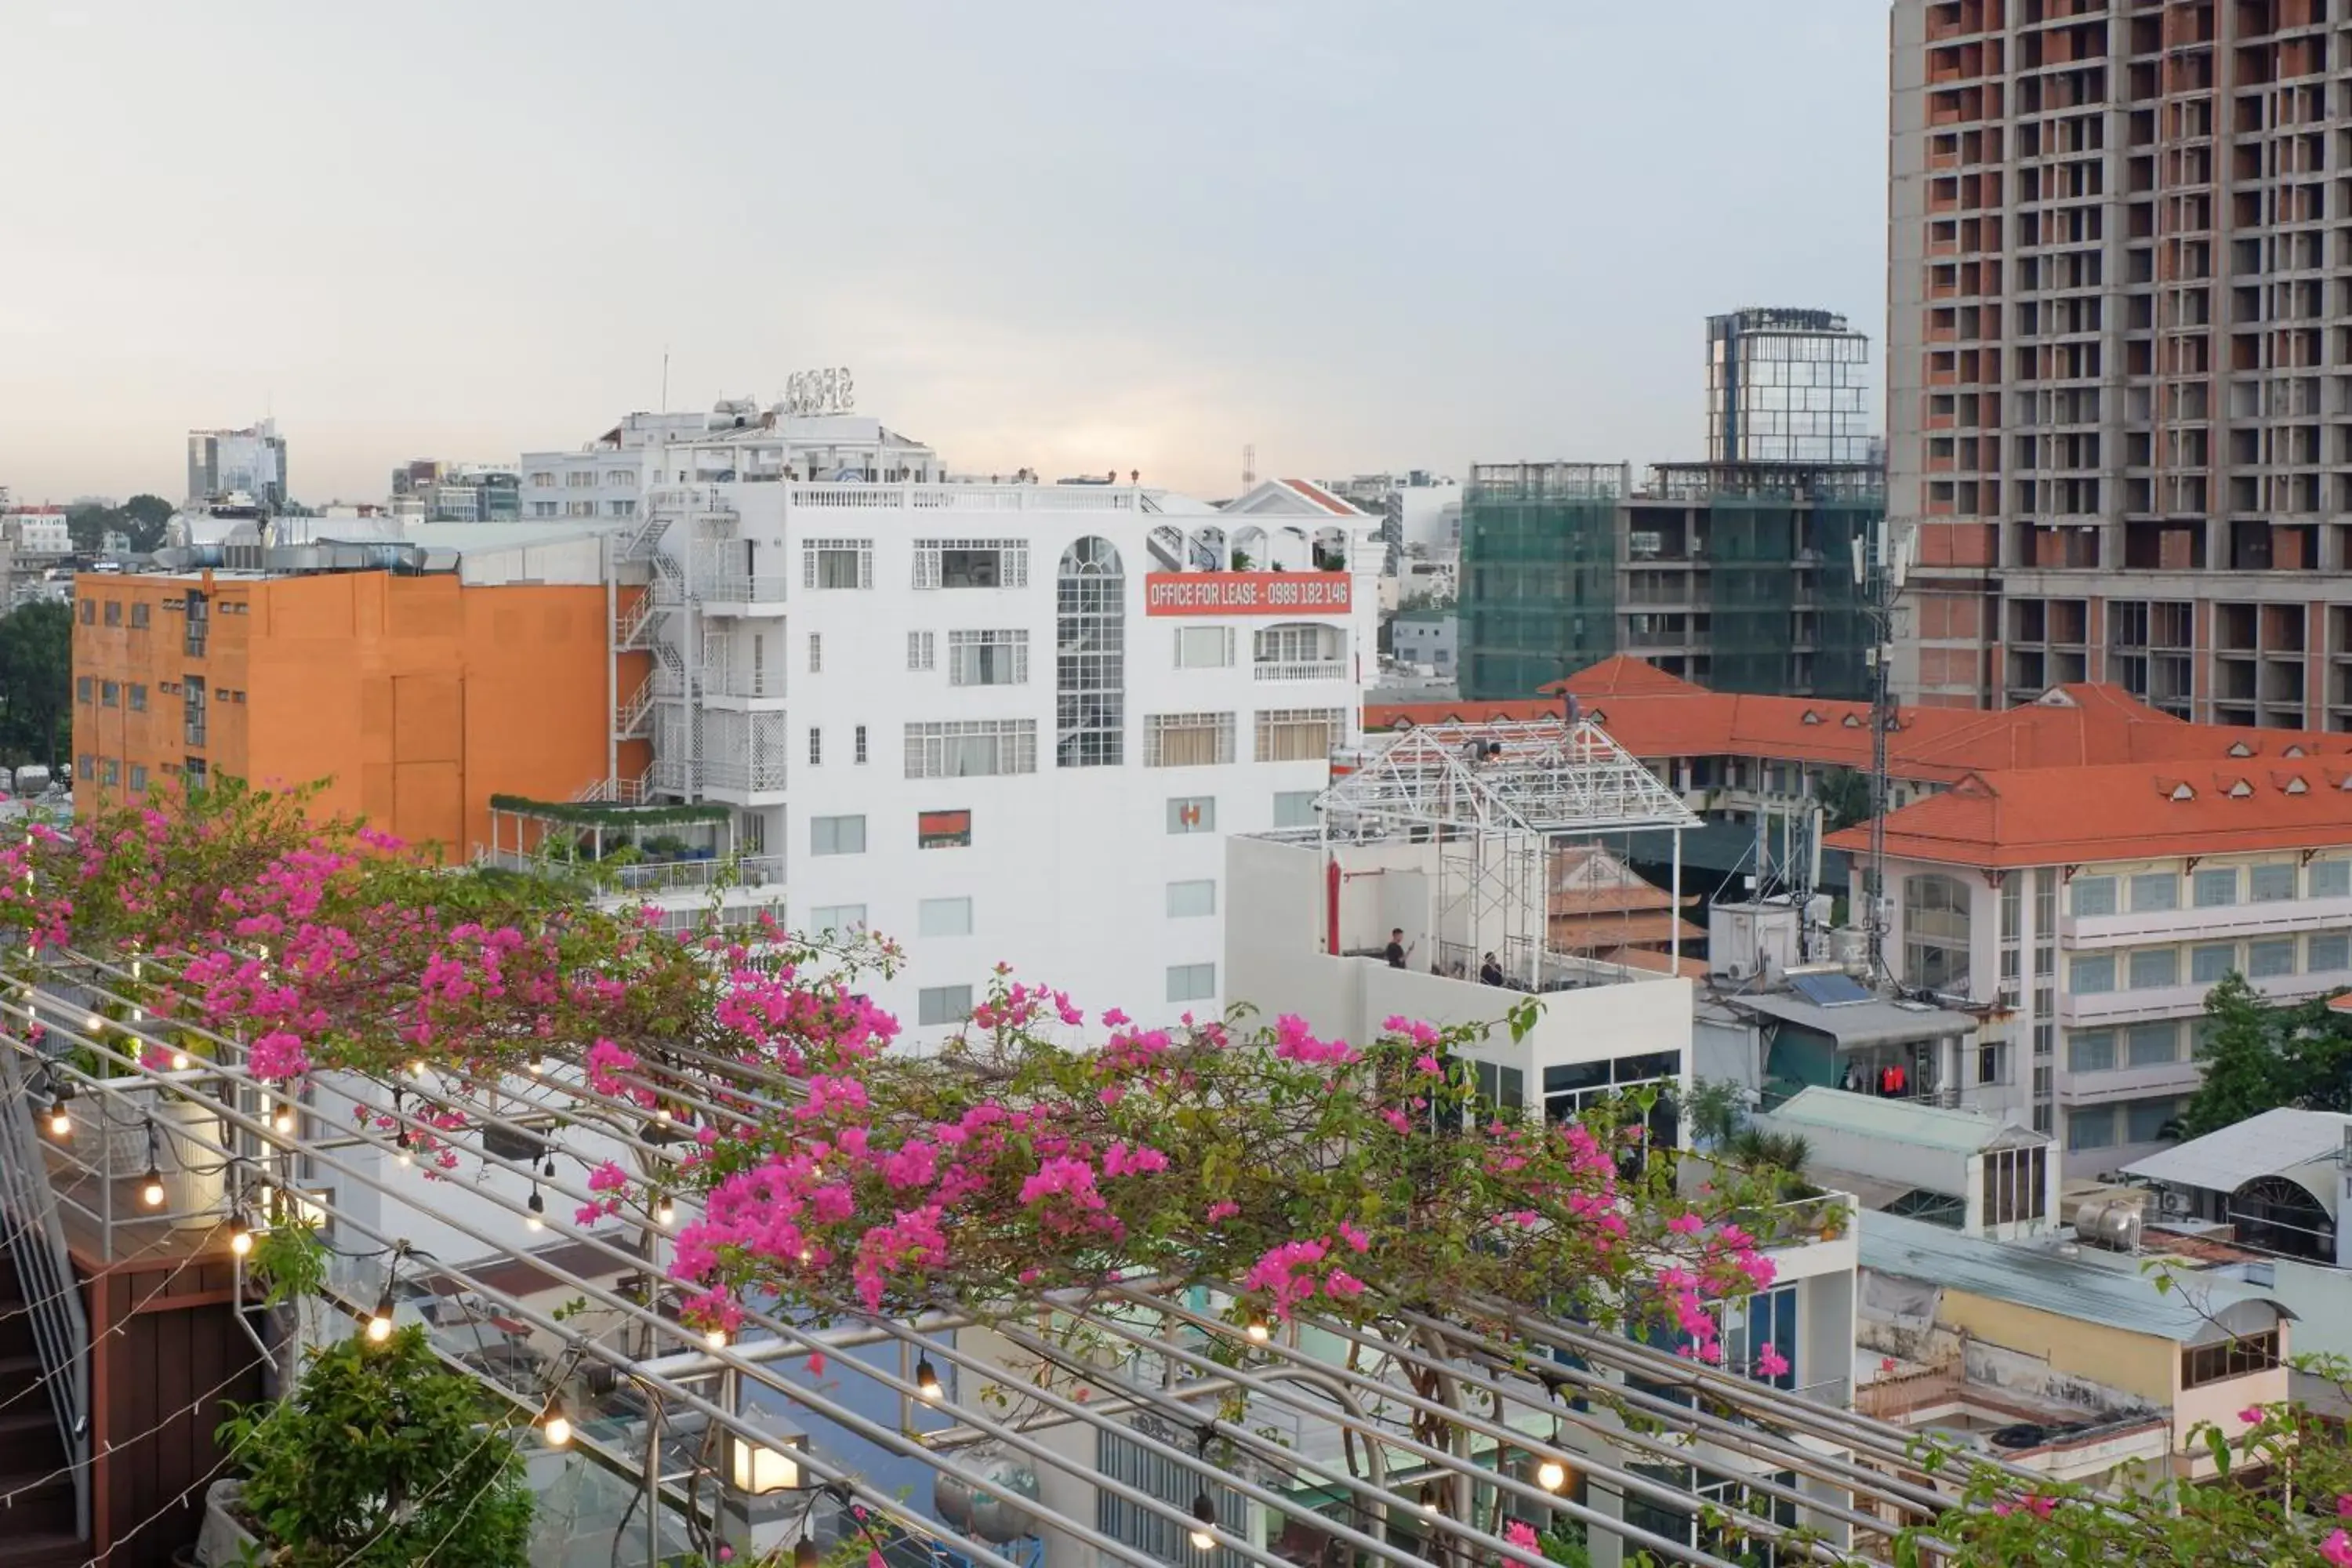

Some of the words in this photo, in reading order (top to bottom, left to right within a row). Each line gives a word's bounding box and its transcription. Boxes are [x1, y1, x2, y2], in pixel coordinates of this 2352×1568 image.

[1151, 583, 1192, 604] OFFICE
[1196, 583, 1218, 604] FOR
[1221, 583, 1257, 604] LEASE
[1301, 583, 1323, 604] 182
